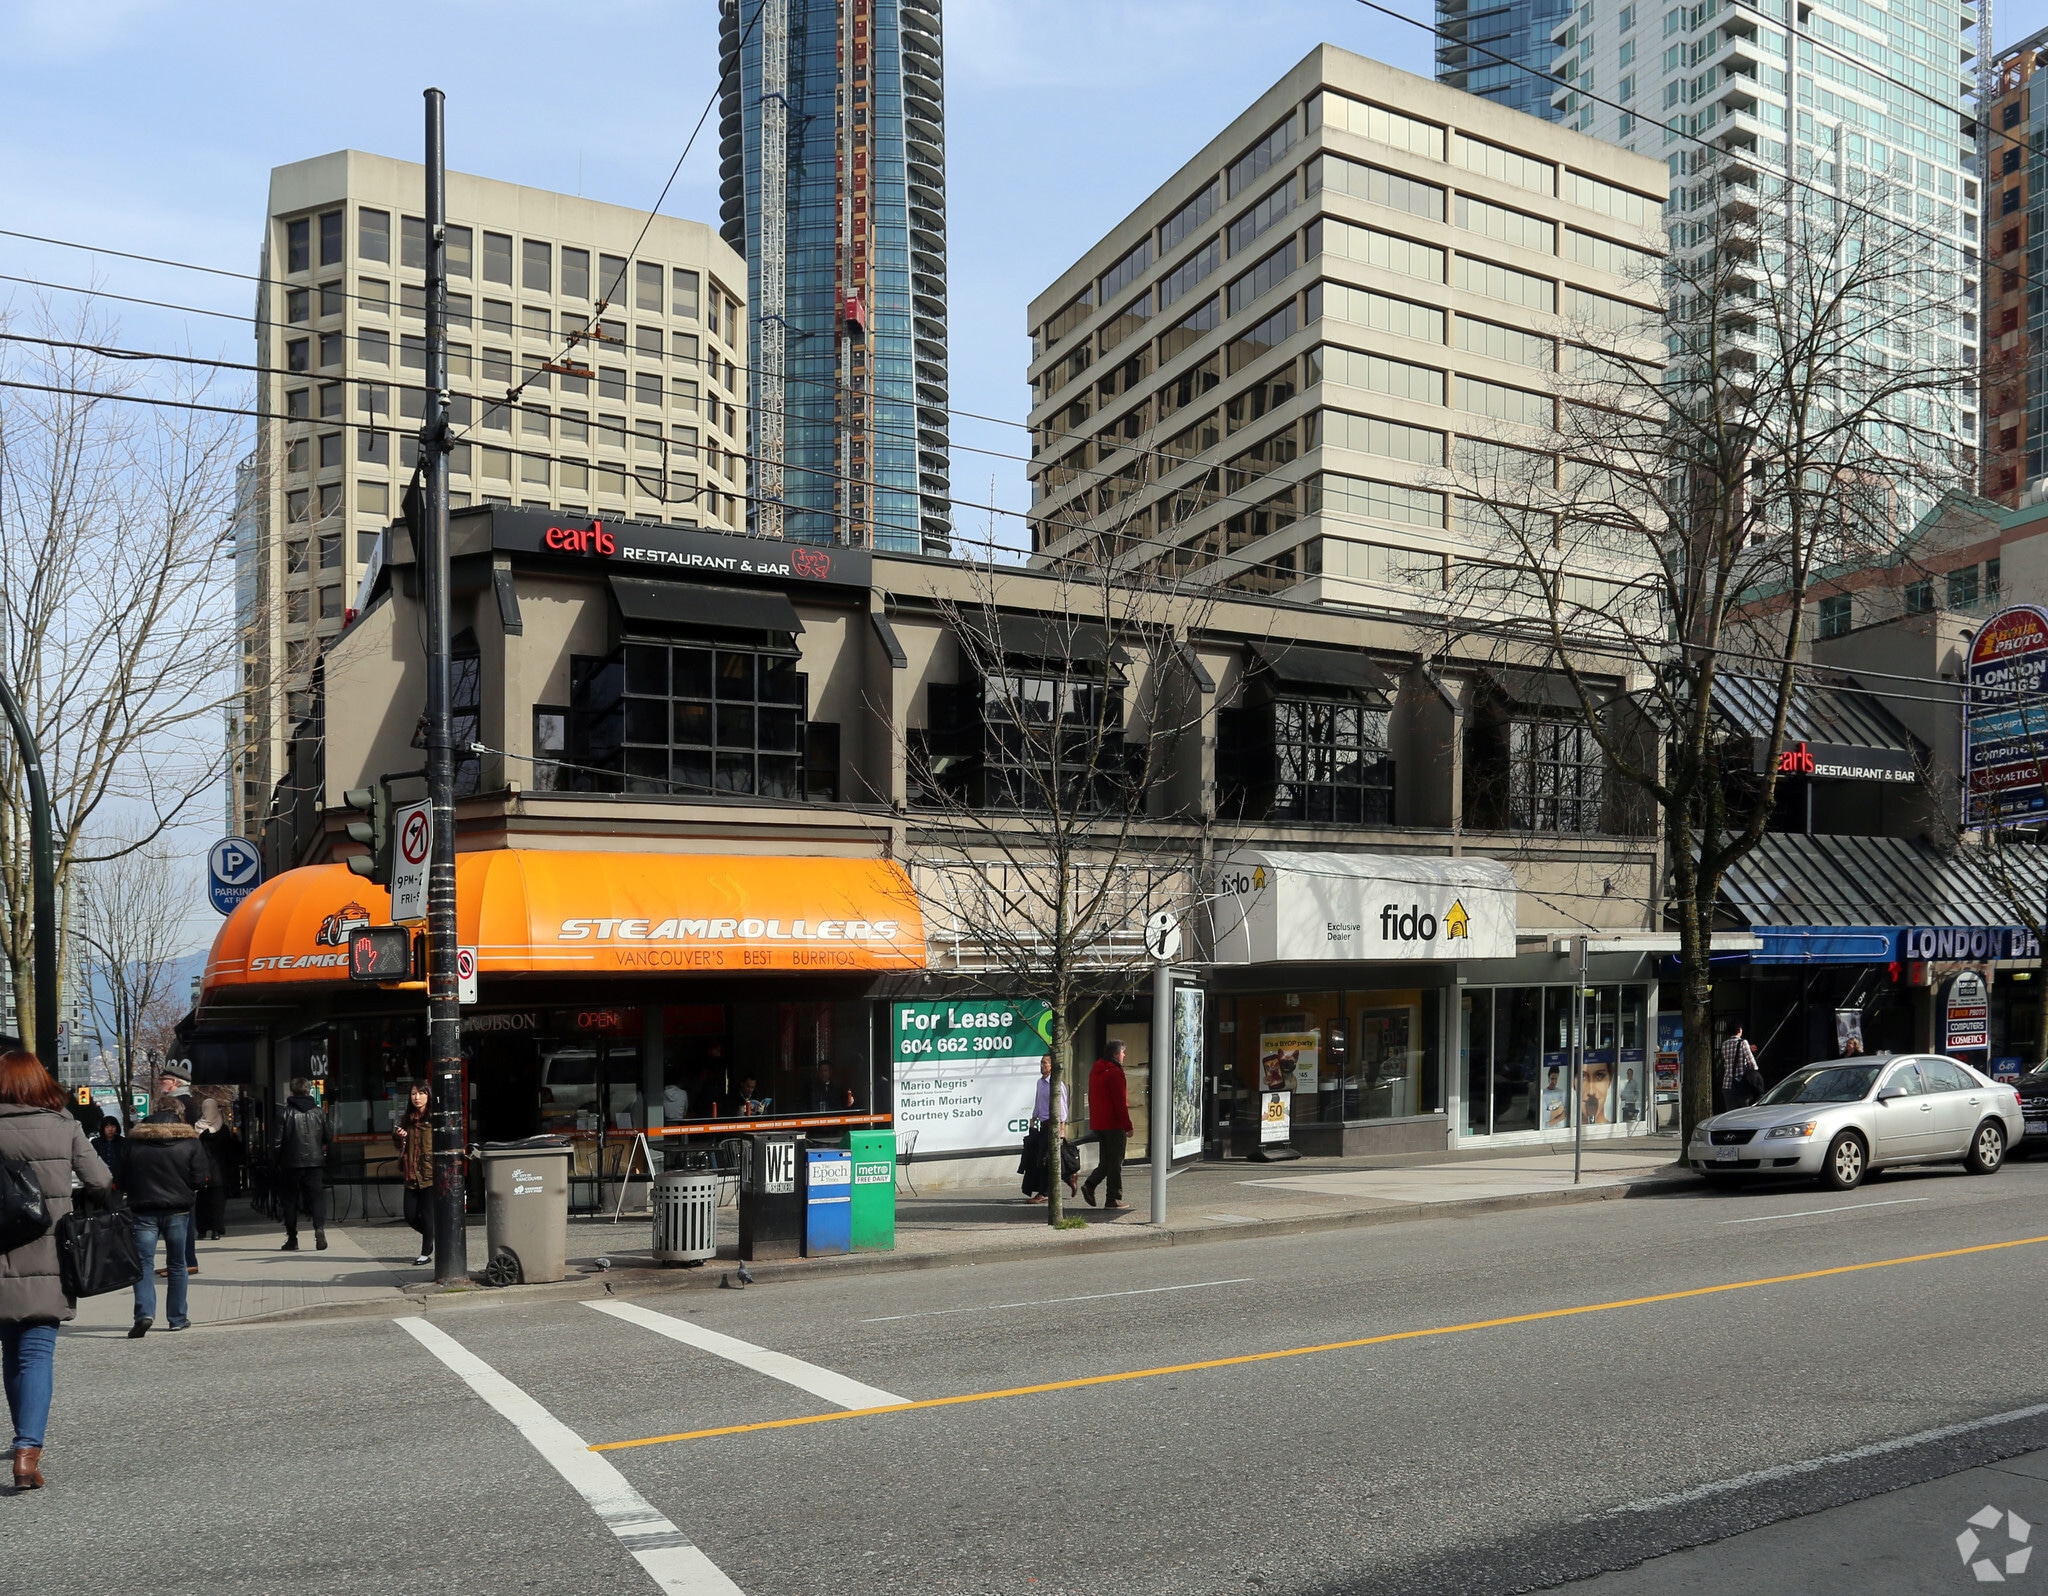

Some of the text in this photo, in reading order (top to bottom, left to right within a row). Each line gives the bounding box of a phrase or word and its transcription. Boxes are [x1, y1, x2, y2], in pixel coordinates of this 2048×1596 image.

[545, 520, 790, 576] earls RESTAURANT & BAR
[1994, 632, 2044, 654] PHOTO
[1975, 660, 2046, 686] LONDON
[1815, 764, 1884, 780] RESTAURANT
[1884, 769, 1893, 780] &
[1894, 770, 1915, 782] BAR
[1979, 768, 2039, 786] COSMETICS
[1221, 872, 1250, 897] fido
[557, 917, 901, 941] STEAMROLLERS
[1327, 922, 1361, 932] Exclusive
[1380, 904, 1438, 941] fido
[1327, 932, 1352, 941] Dealer
[1906, 927, 2040, 960] LONDON DR
[614, 950, 855, 967] VANCOUVER'S BEST BURRITOS
[468, 1012, 536, 1032] ROBSON
[577, 1011, 618, 1029] OPEN
[900, 1006, 1014, 1031] For Lease
[1950, 1021, 1985, 1031] COMPUTERS
[900, 1035, 1013, 1055] 604 662 3000
[1297, 1038, 1314, 1048] party
[1951, 1034, 1983, 1045] COSMETICS
[900, 1078, 969, 1092] Mario Negris
[900, 1094, 983, 1108] Martin Moriarty
[900, 1109, 949, 1123] Courtney
[952, 1107, 984, 1119] Szabo
[1269, 1104, 1283, 1118] 50
[766, 1144, 794, 1183] WE
[858, 1162, 889, 1176] metro
[812, 1164, 849, 1182] Epoch
[856, 1174, 889, 1183] FREE DAILY
